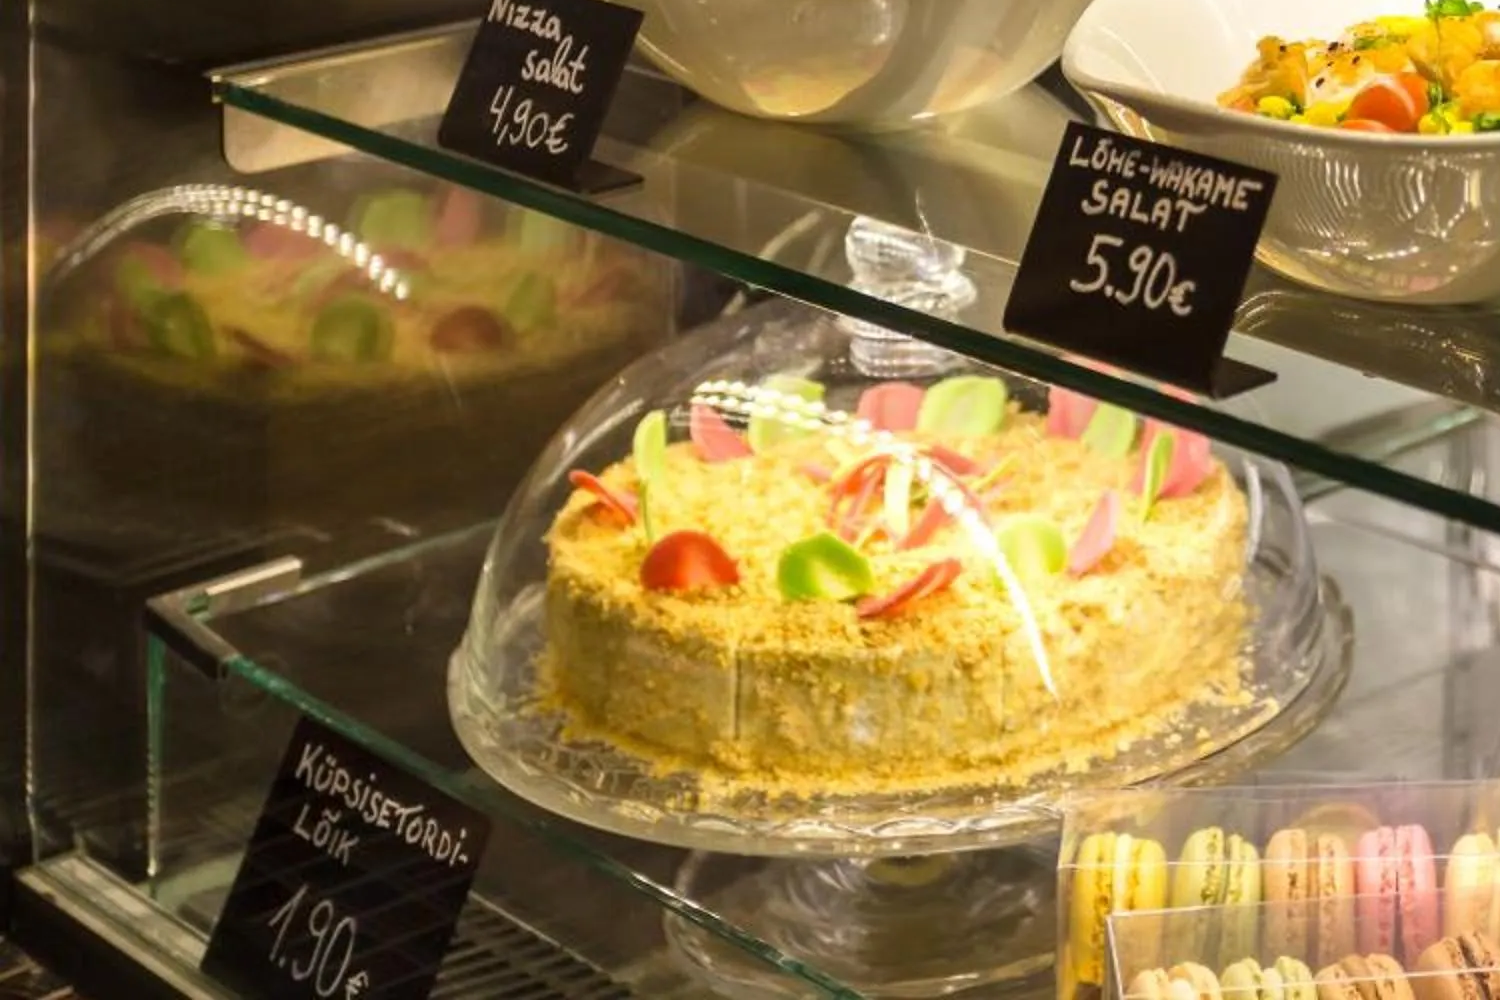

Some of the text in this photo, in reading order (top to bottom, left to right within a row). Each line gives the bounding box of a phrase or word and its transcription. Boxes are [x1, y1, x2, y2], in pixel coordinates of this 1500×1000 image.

[520, 35, 590, 95] salat
[488, 84, 576, 155] 4,90€
[1080, 178, 1208, 233] SALAT
[1068, 233, 1197, 317] 5.90€
[292, 803, 360, 868] LÕIK
[267, 884, 370, 1000] 1.90€
